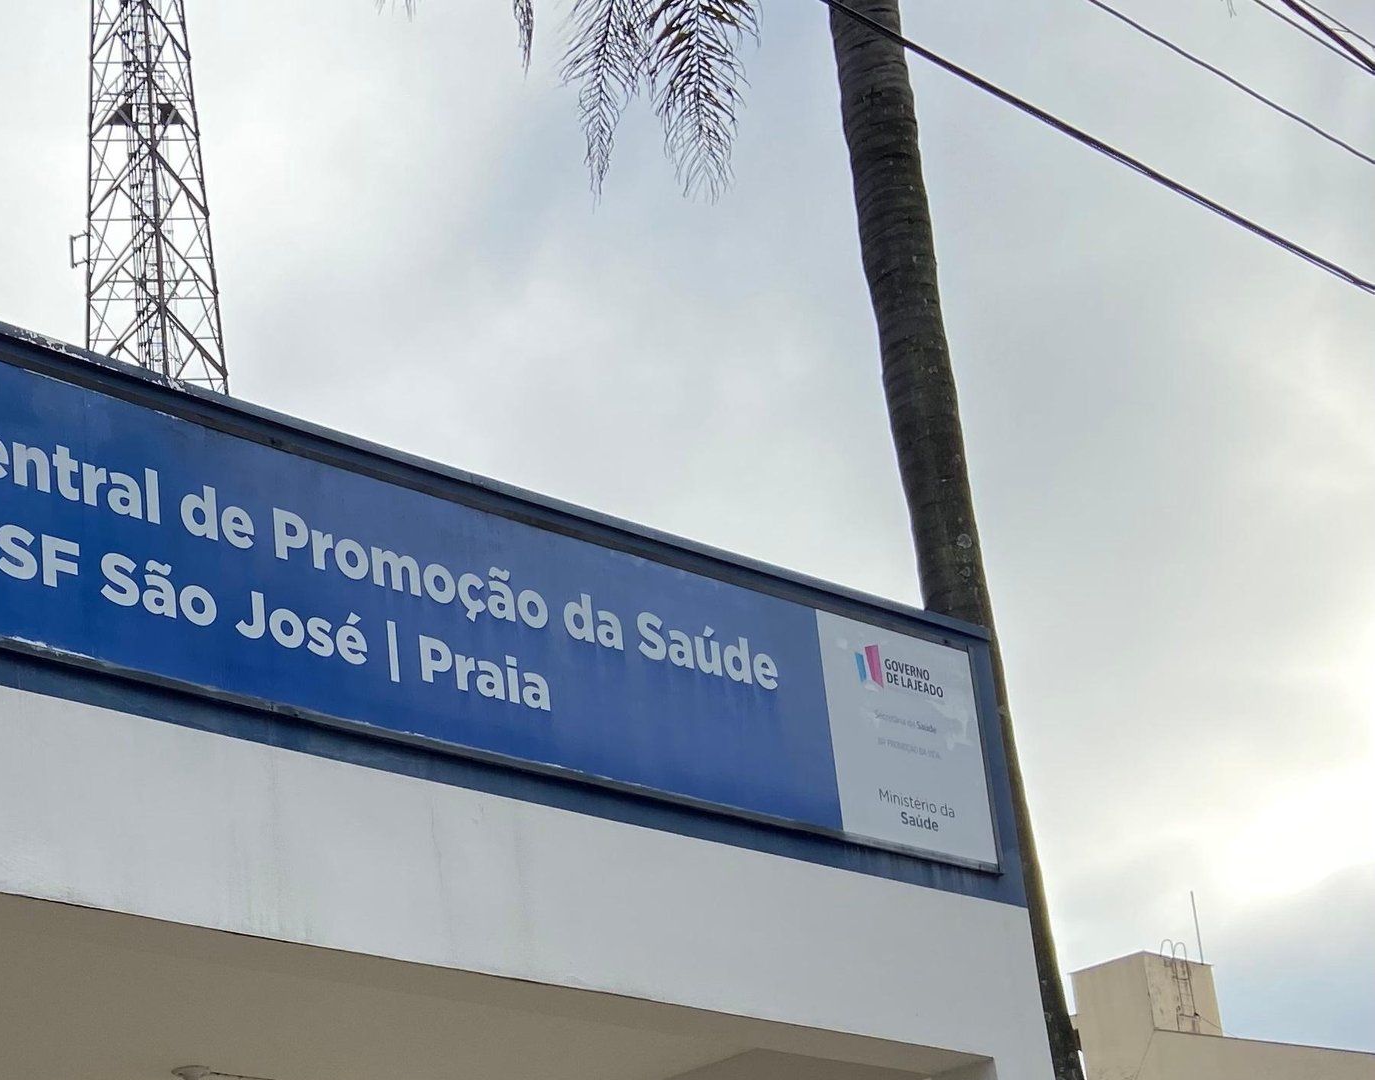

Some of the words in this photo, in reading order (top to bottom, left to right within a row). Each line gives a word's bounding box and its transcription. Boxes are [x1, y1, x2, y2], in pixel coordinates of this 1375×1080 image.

[180, 484, 255, 550] de
[273, 506, 549, 629] Promoção
[563, 592, 624, 652] da
[635, 612, 780, 690] Saúde
[100, 550, 218, 627] São
[235, 590, 368, 665] José
[419, 634, 551, 713] Praia
[884, 658, 930, 681] GOVERNO
[886, 671, 900, 686] DE
[901, 677, 944, 698] LAJEADO
[900, 811, 939, 832] Saúde
[940, 803, 956, 819] da
